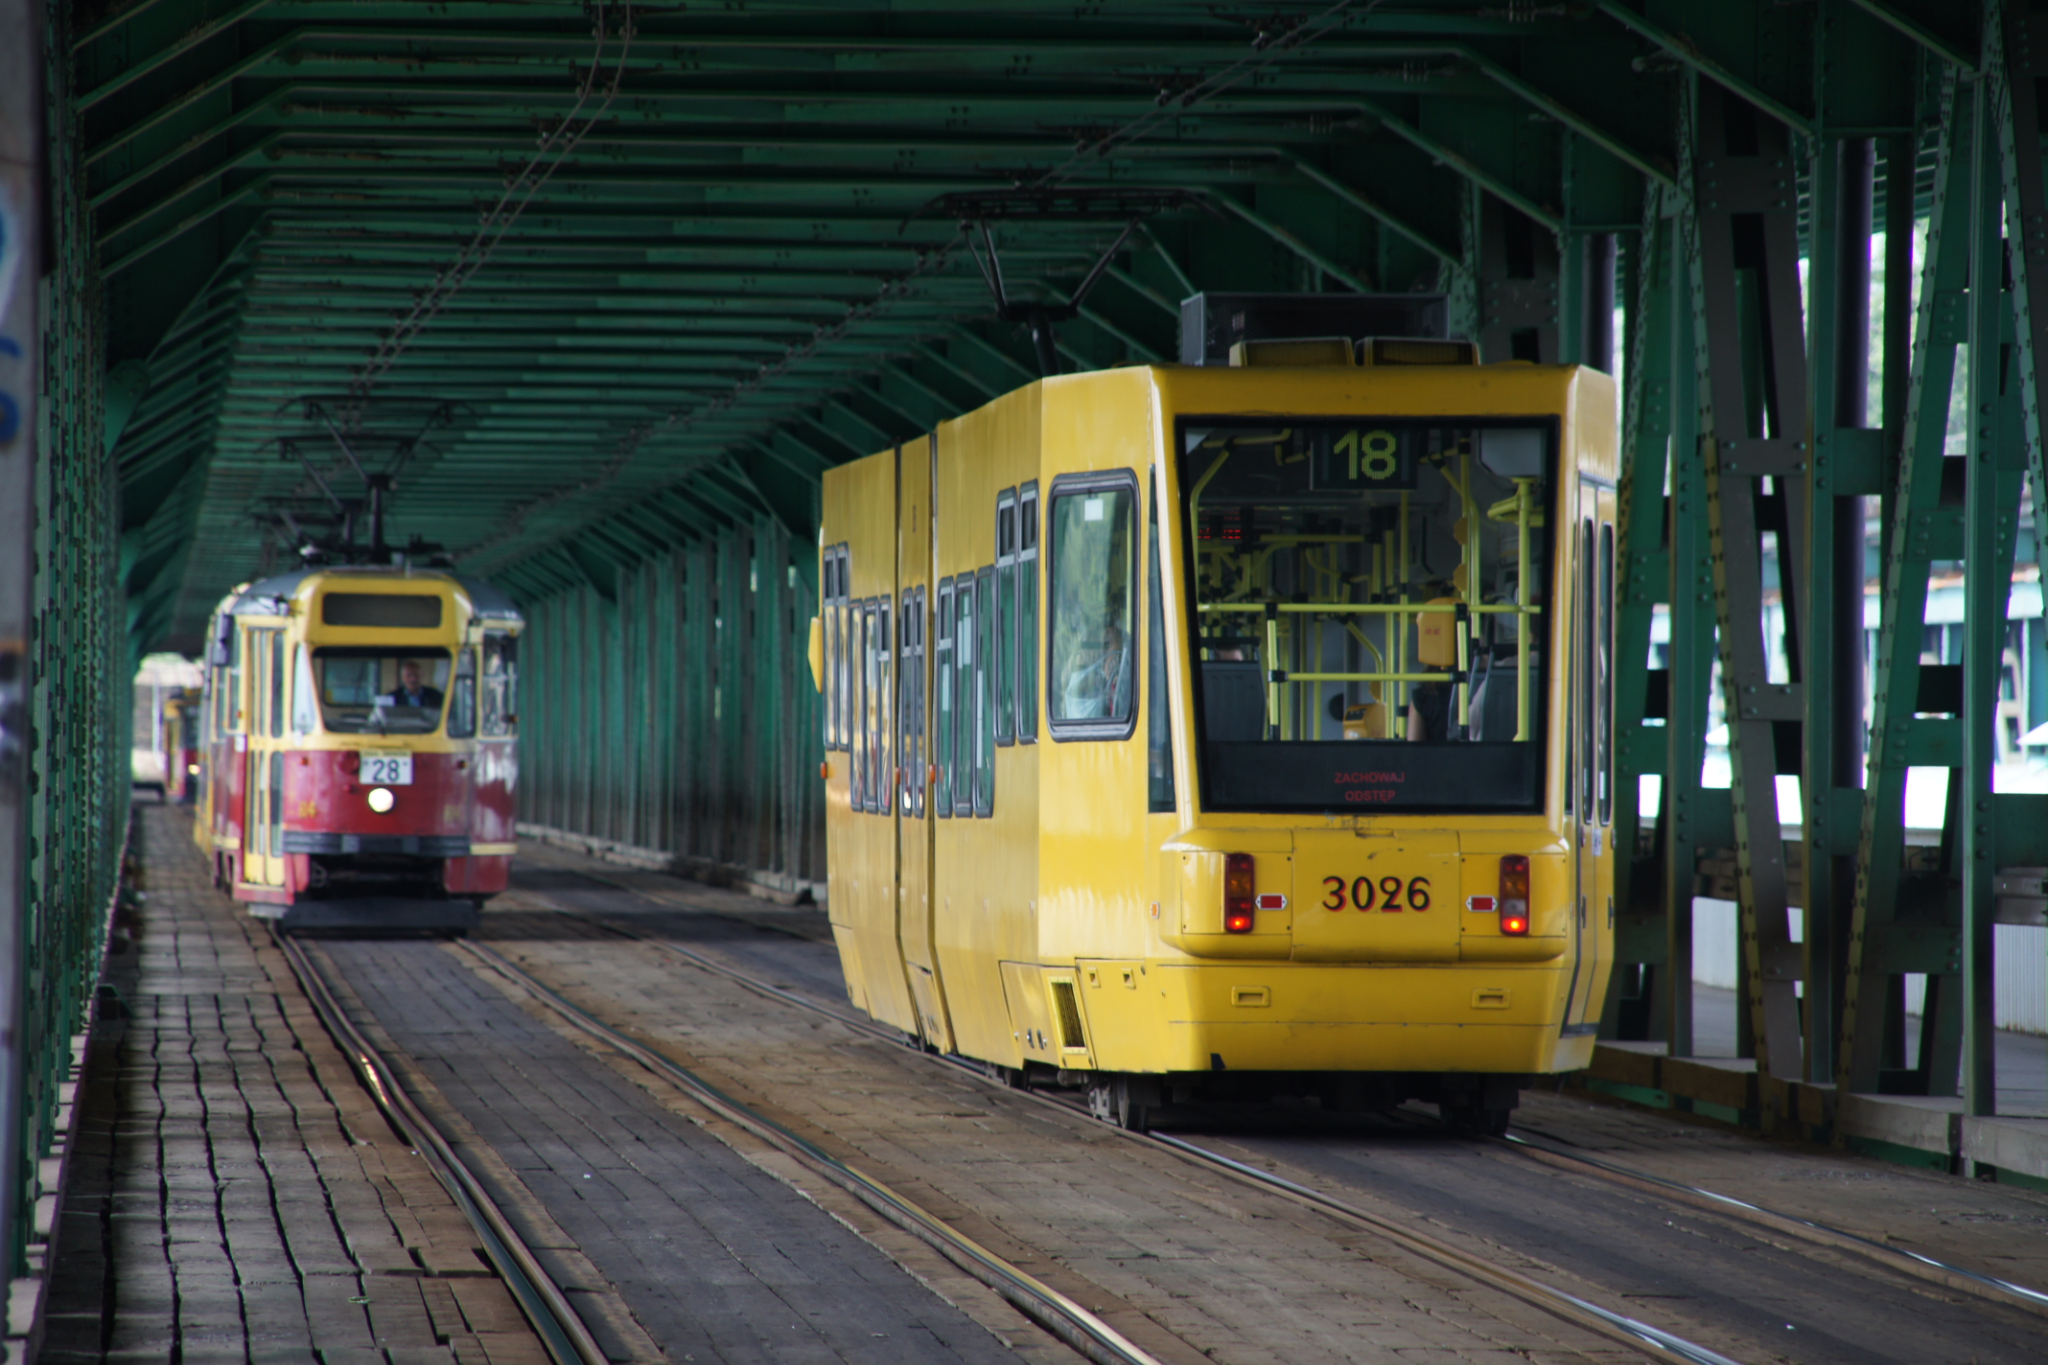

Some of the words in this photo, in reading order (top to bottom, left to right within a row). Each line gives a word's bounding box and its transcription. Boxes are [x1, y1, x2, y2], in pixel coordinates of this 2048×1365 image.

[1333, 429, 1396, 480] 18
[372, 759, 400, 782] 28
[1334, 772, 1405, 784] ZACHOWAJ
[1345, 790, 1396, 803] ODSTĘP
[1322, 876, 1431, 912] 3026
